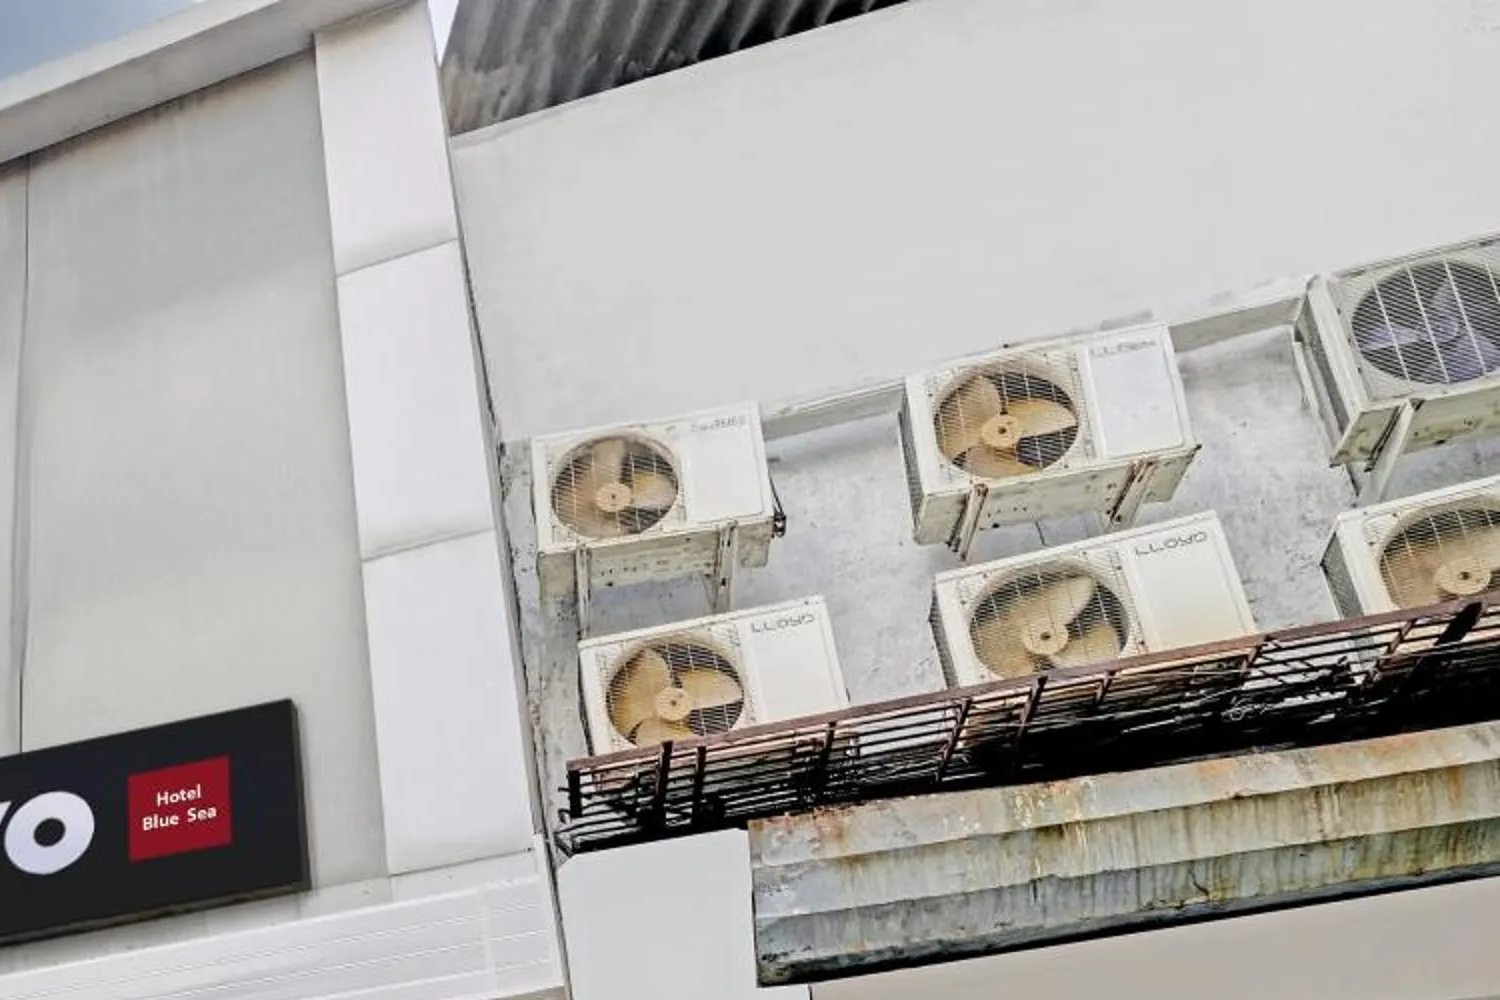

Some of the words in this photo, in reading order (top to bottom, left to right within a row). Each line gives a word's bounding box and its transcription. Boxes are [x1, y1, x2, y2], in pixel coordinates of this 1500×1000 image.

[156, 783, 201, 807] Hotel
[142, 813, 179, 831] Blue
[187, 806, 217, 823] Sea
